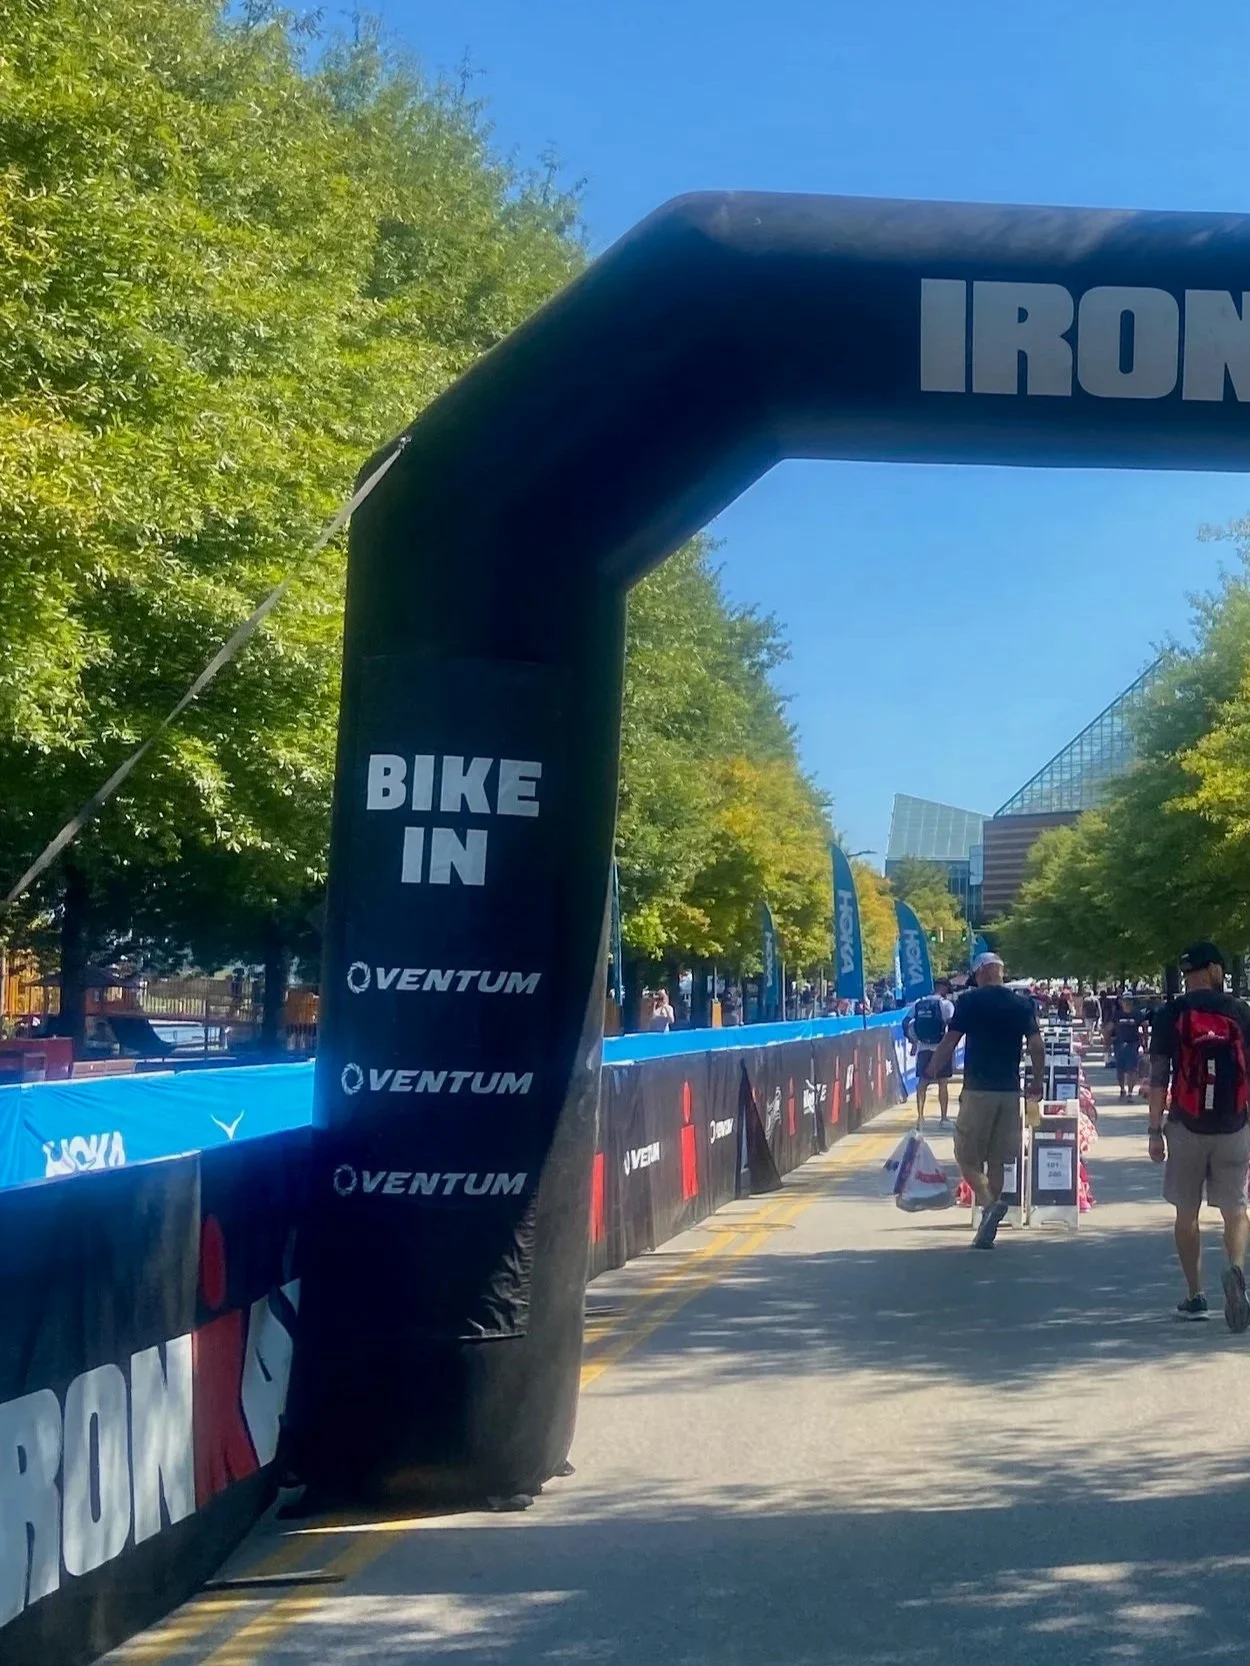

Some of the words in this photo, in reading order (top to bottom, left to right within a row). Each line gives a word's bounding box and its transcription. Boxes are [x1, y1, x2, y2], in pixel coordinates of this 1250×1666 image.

[366, 753, 542, 817] BIKE
[401, 826, 488, 886] IN
[375, 967, 542, 994] VENTUM
[368, 1069, 534, 1095] VENTUM
[361, 1170, 528, 1196] VENTUM
